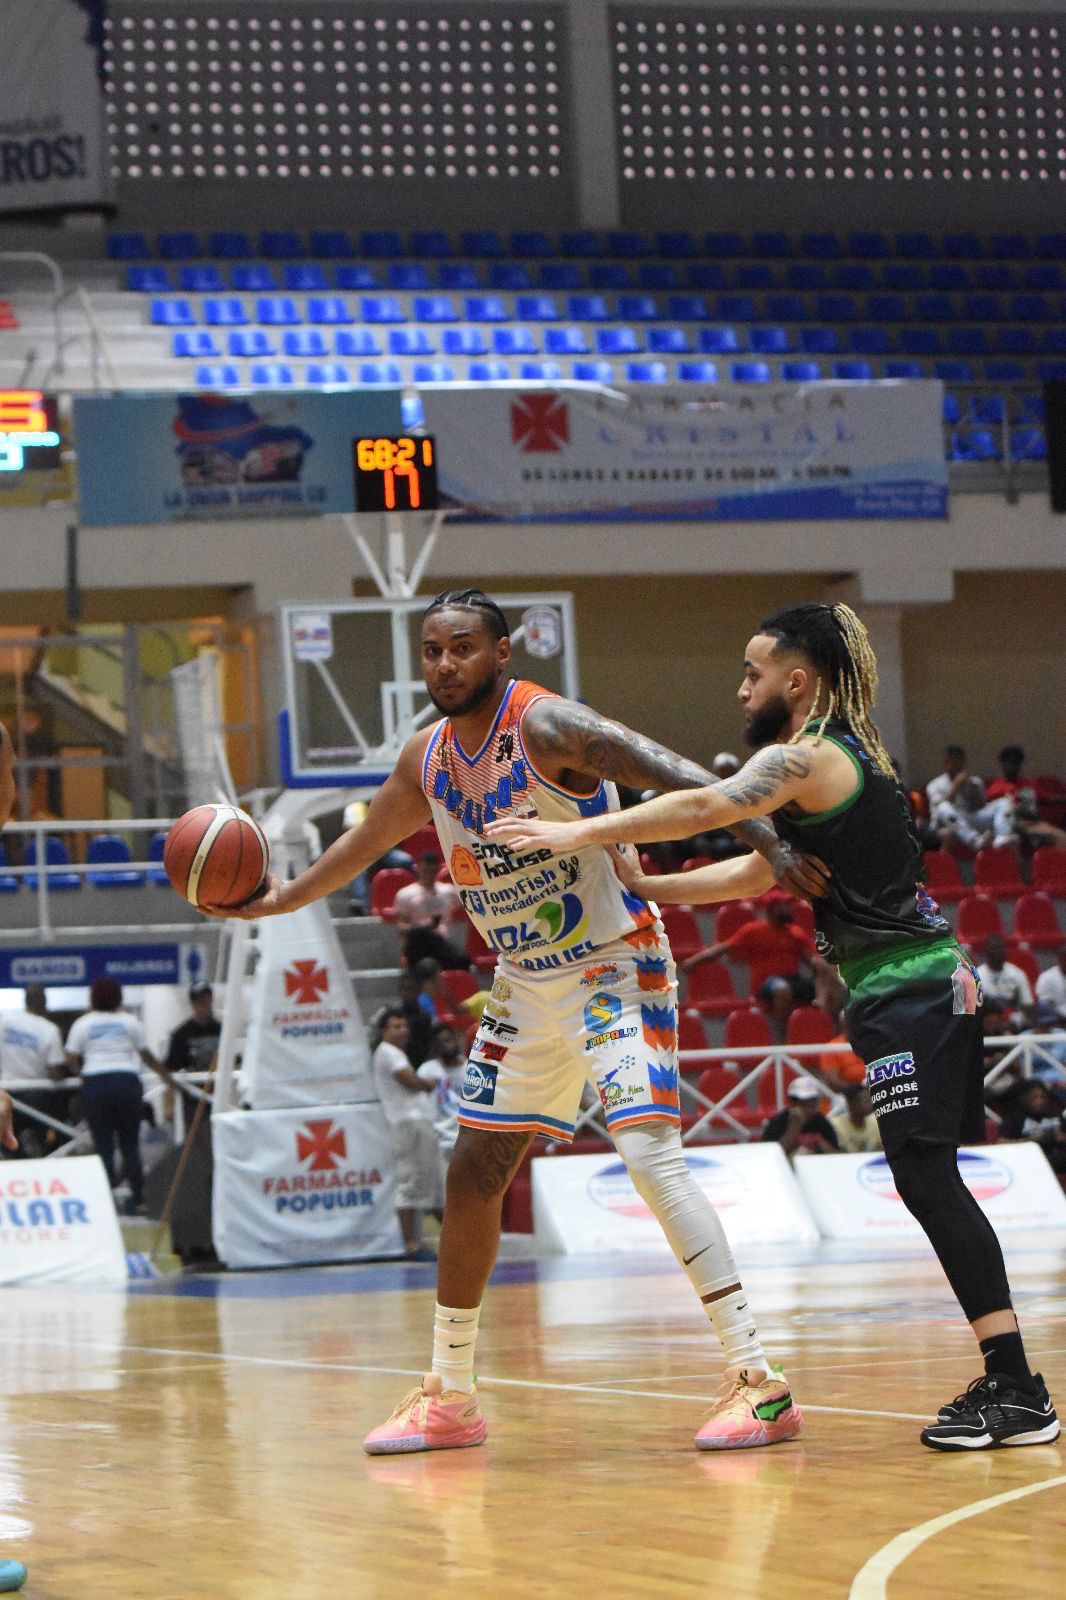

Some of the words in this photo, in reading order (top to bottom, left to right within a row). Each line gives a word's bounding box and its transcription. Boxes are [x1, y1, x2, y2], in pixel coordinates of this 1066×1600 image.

[384, 467, 420, 508] 17
[480, 869, 558, 905] TonyFish
[281, 1022, 344, 1039] POPULAR
[890, 1080, 919, 1096] JOSÉ
[275, 1188, 374, 1214] POPULAR
